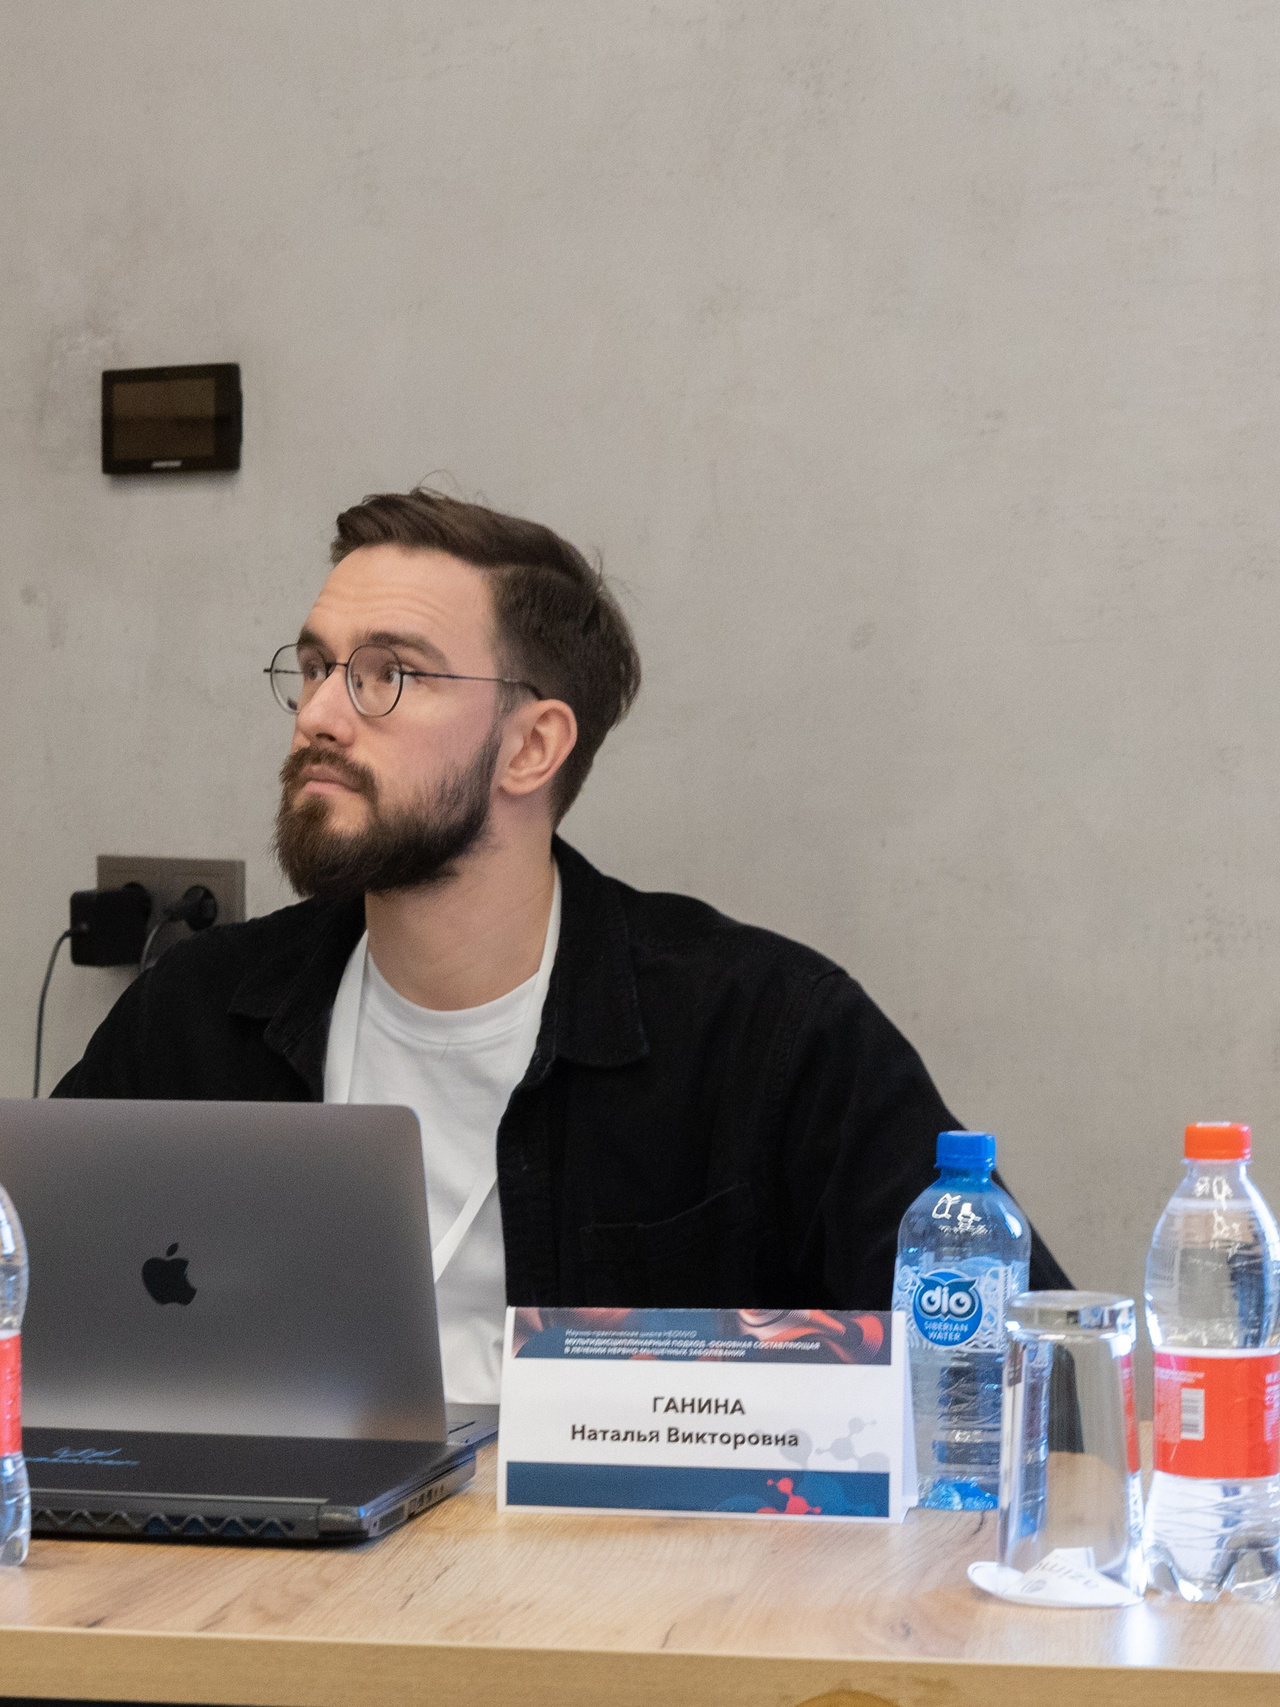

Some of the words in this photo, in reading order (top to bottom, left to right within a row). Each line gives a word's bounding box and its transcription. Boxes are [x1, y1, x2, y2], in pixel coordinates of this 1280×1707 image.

[921, 1286, 972, 1315] dio
[923, 1321, 969, 1333] SIBERIAN
[928, 1330, 961, 1342] WATER
[651, 1396, 746, 1416] ГАНИНА
[571, 1423, 660, 1444] Наталья
[667, 1426, 799, 1450] Викторовна
